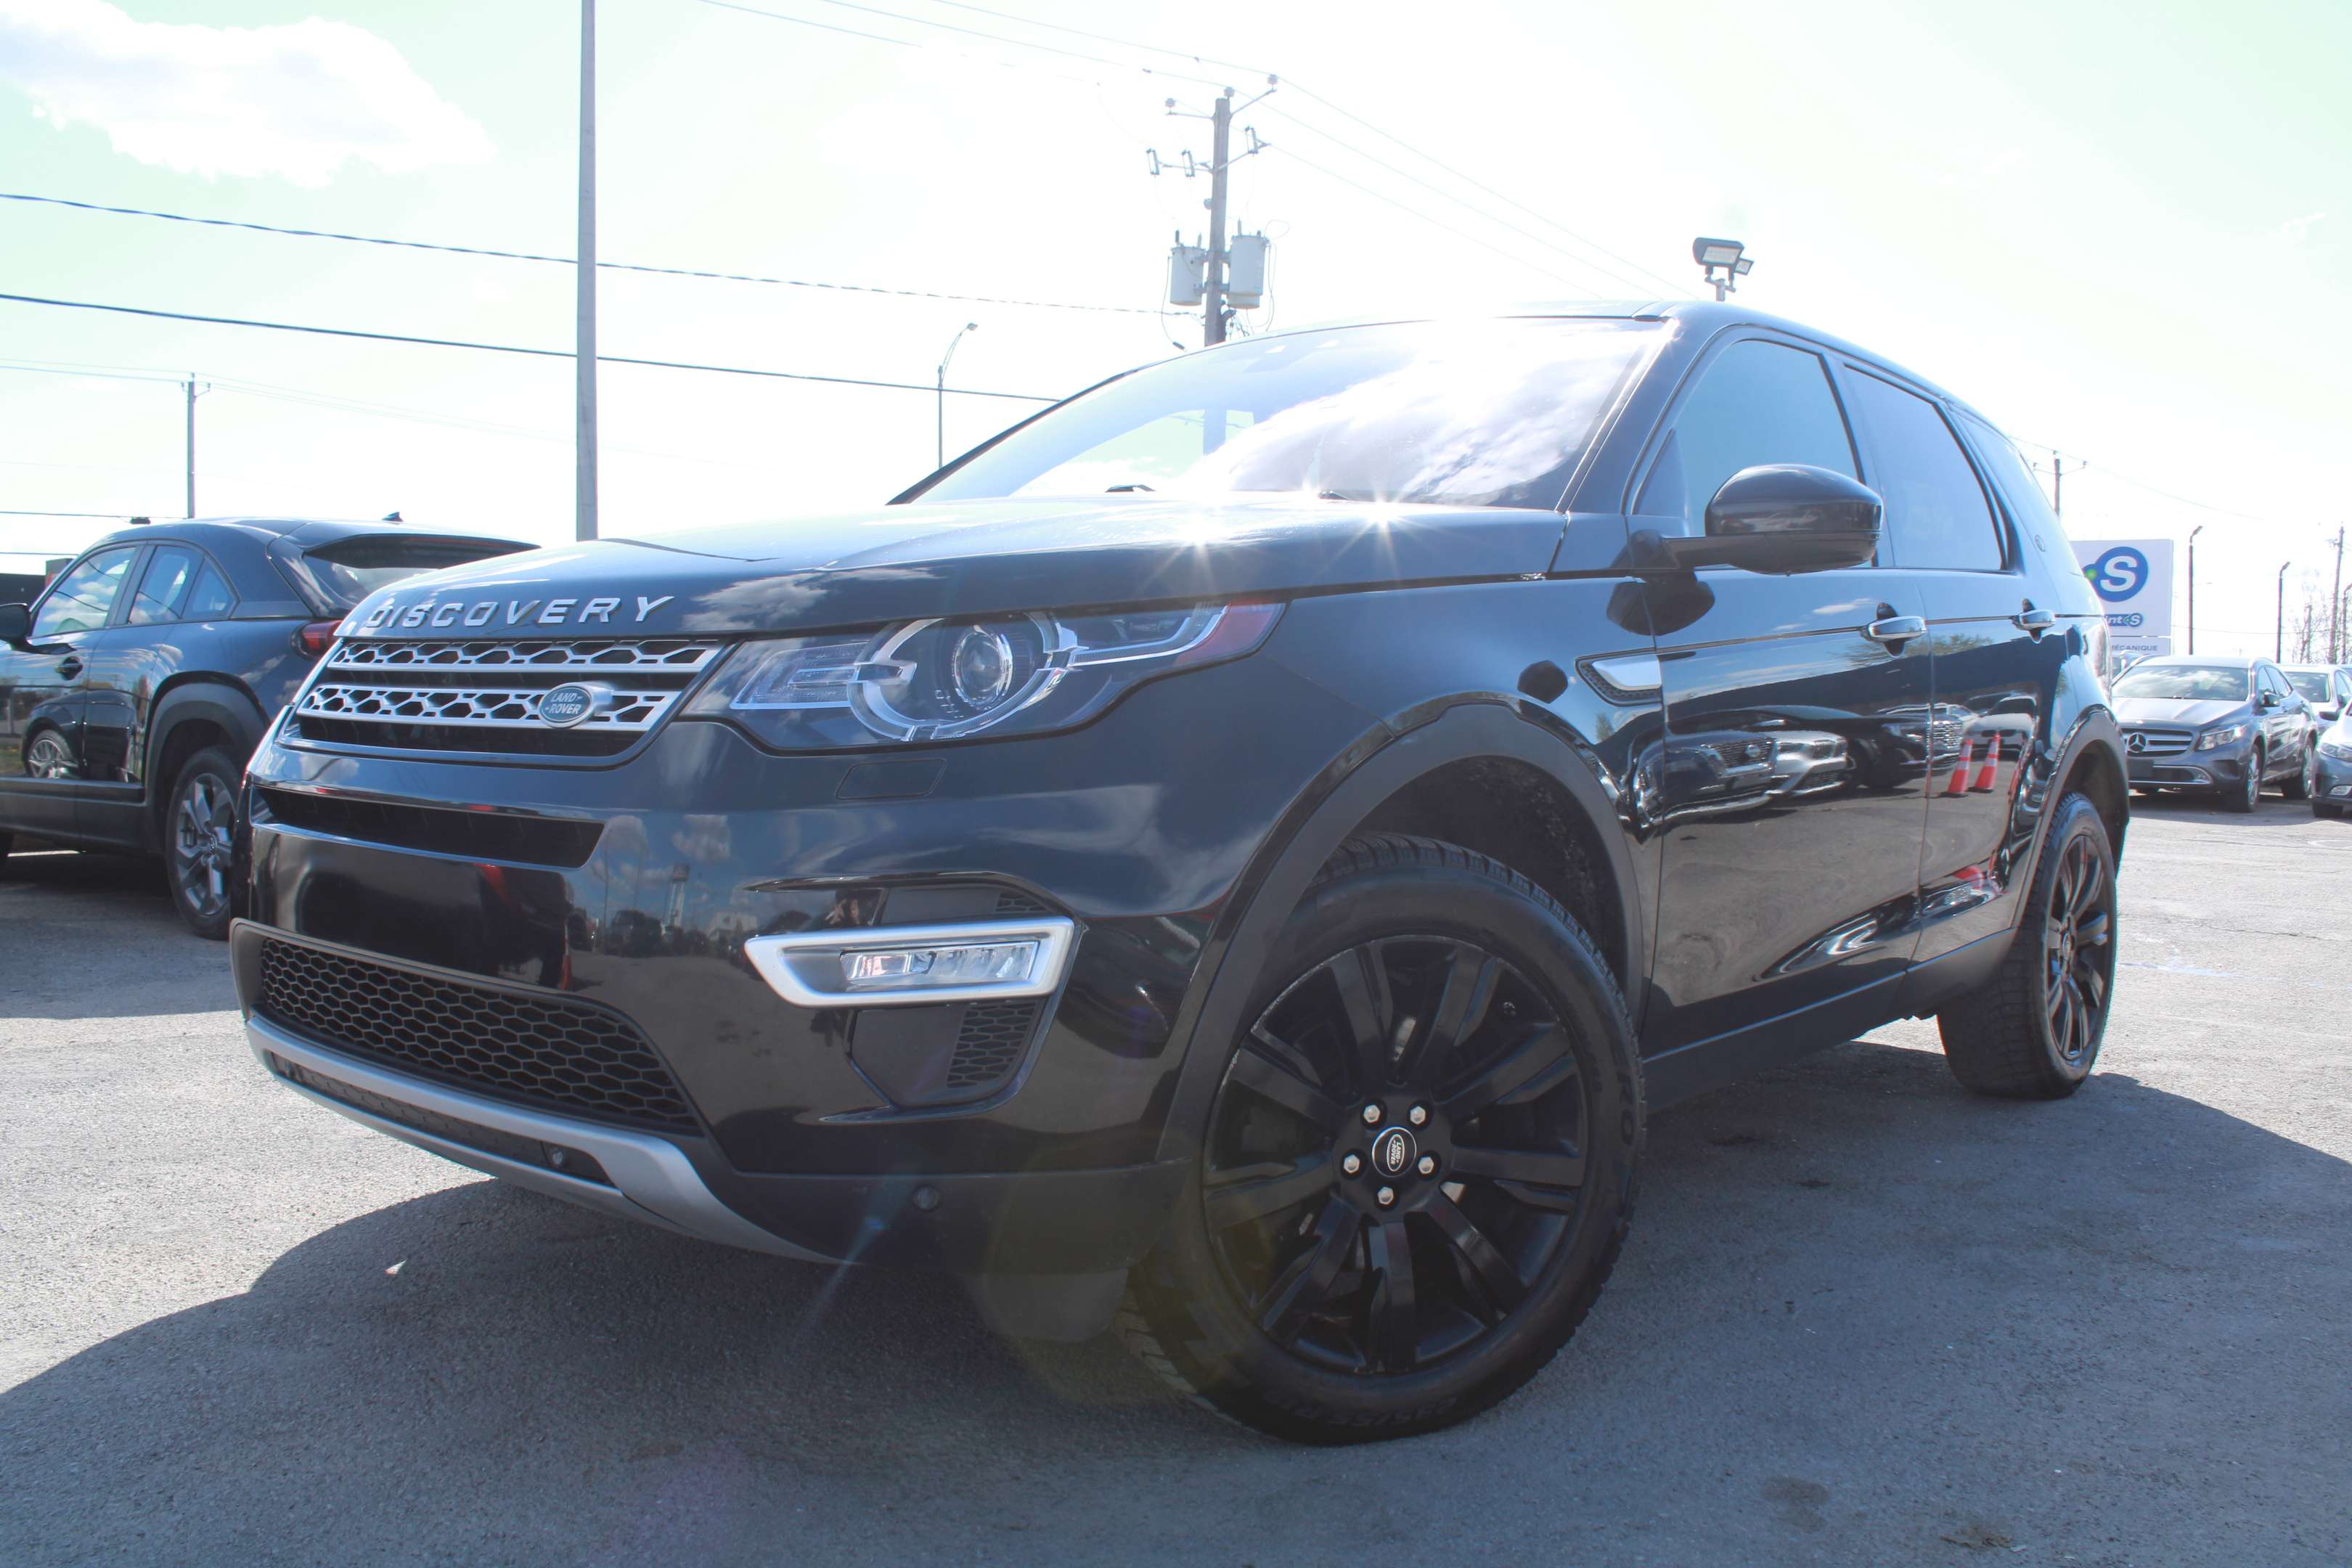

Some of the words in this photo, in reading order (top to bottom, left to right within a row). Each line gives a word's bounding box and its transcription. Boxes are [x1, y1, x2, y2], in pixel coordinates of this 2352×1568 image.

[2100, 555, 2137, 592] S
[364, 595, 675, 629] DISCOVERY
[549, 703, 582, 714] ROVER
[550, 692, 578, 703] LAND
